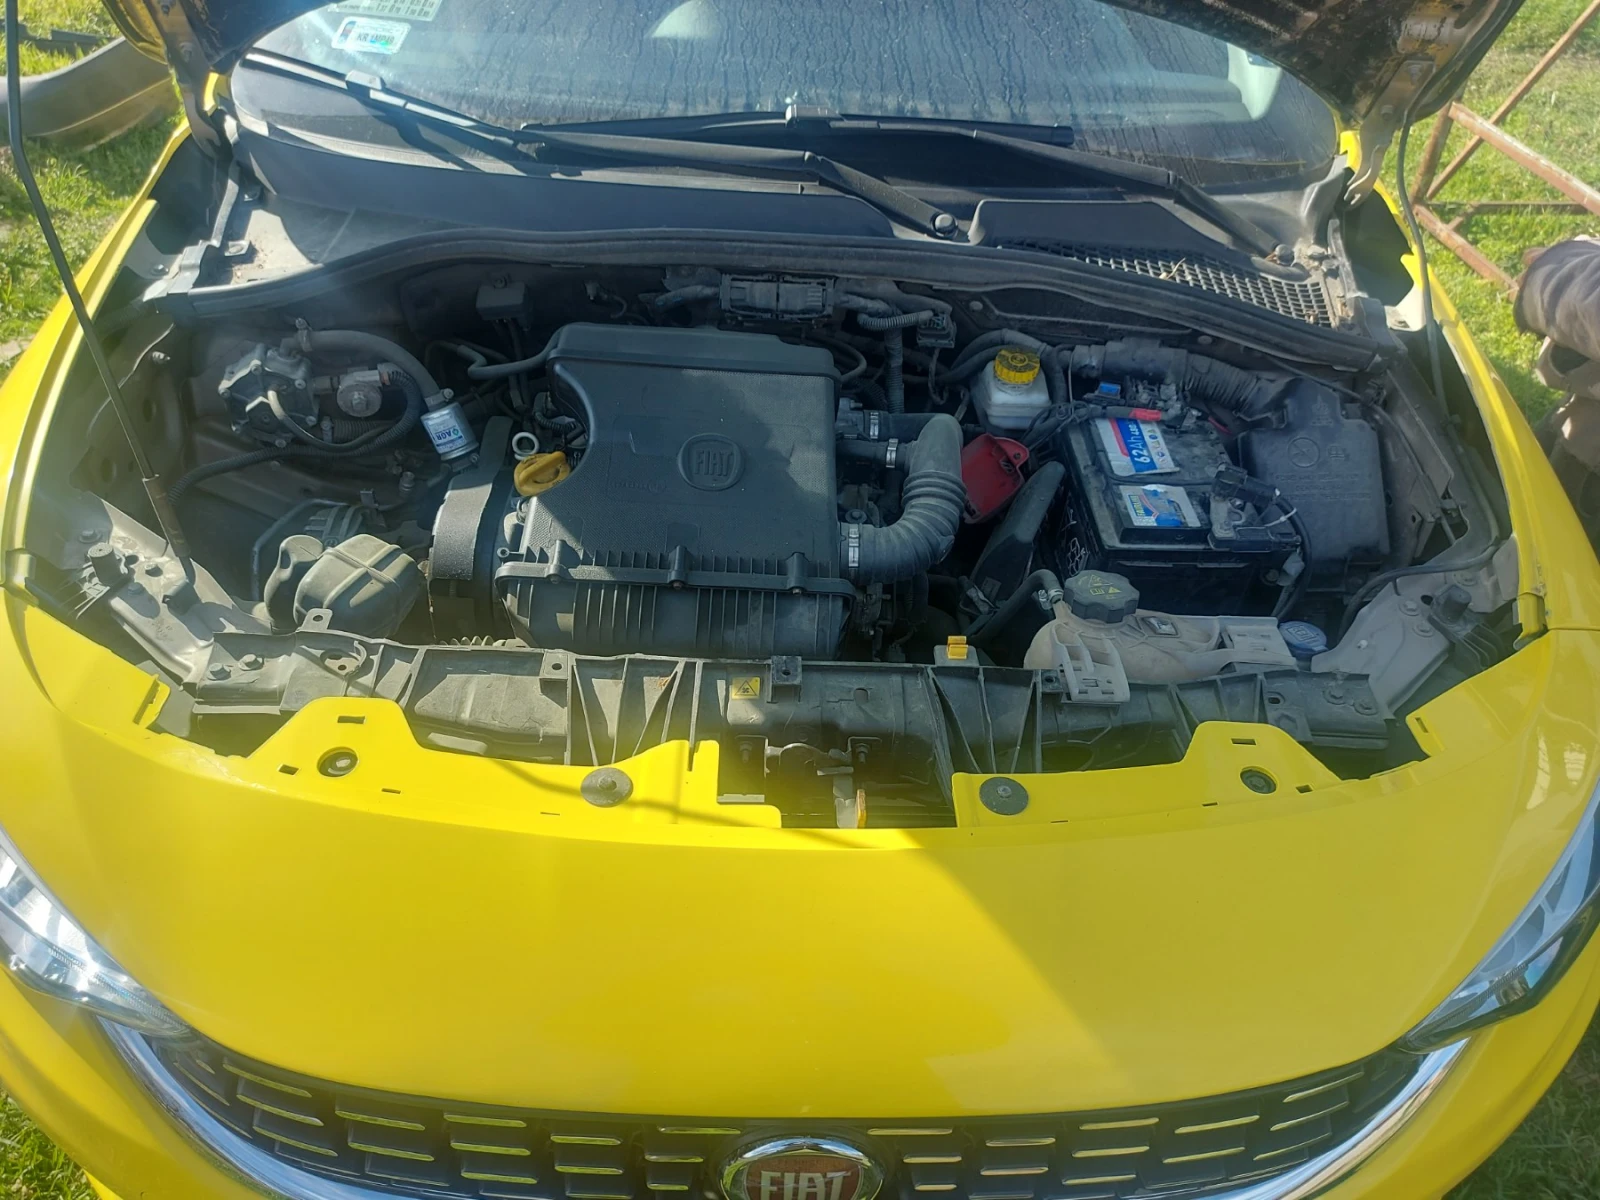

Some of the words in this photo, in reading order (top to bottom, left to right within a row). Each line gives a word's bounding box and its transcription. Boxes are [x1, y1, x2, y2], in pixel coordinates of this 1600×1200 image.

[692, 449, 733, 476] FIAT
[1127, 436, 1151, 463] 62Ah
[760, 1170, 851, 1200] FIAT
